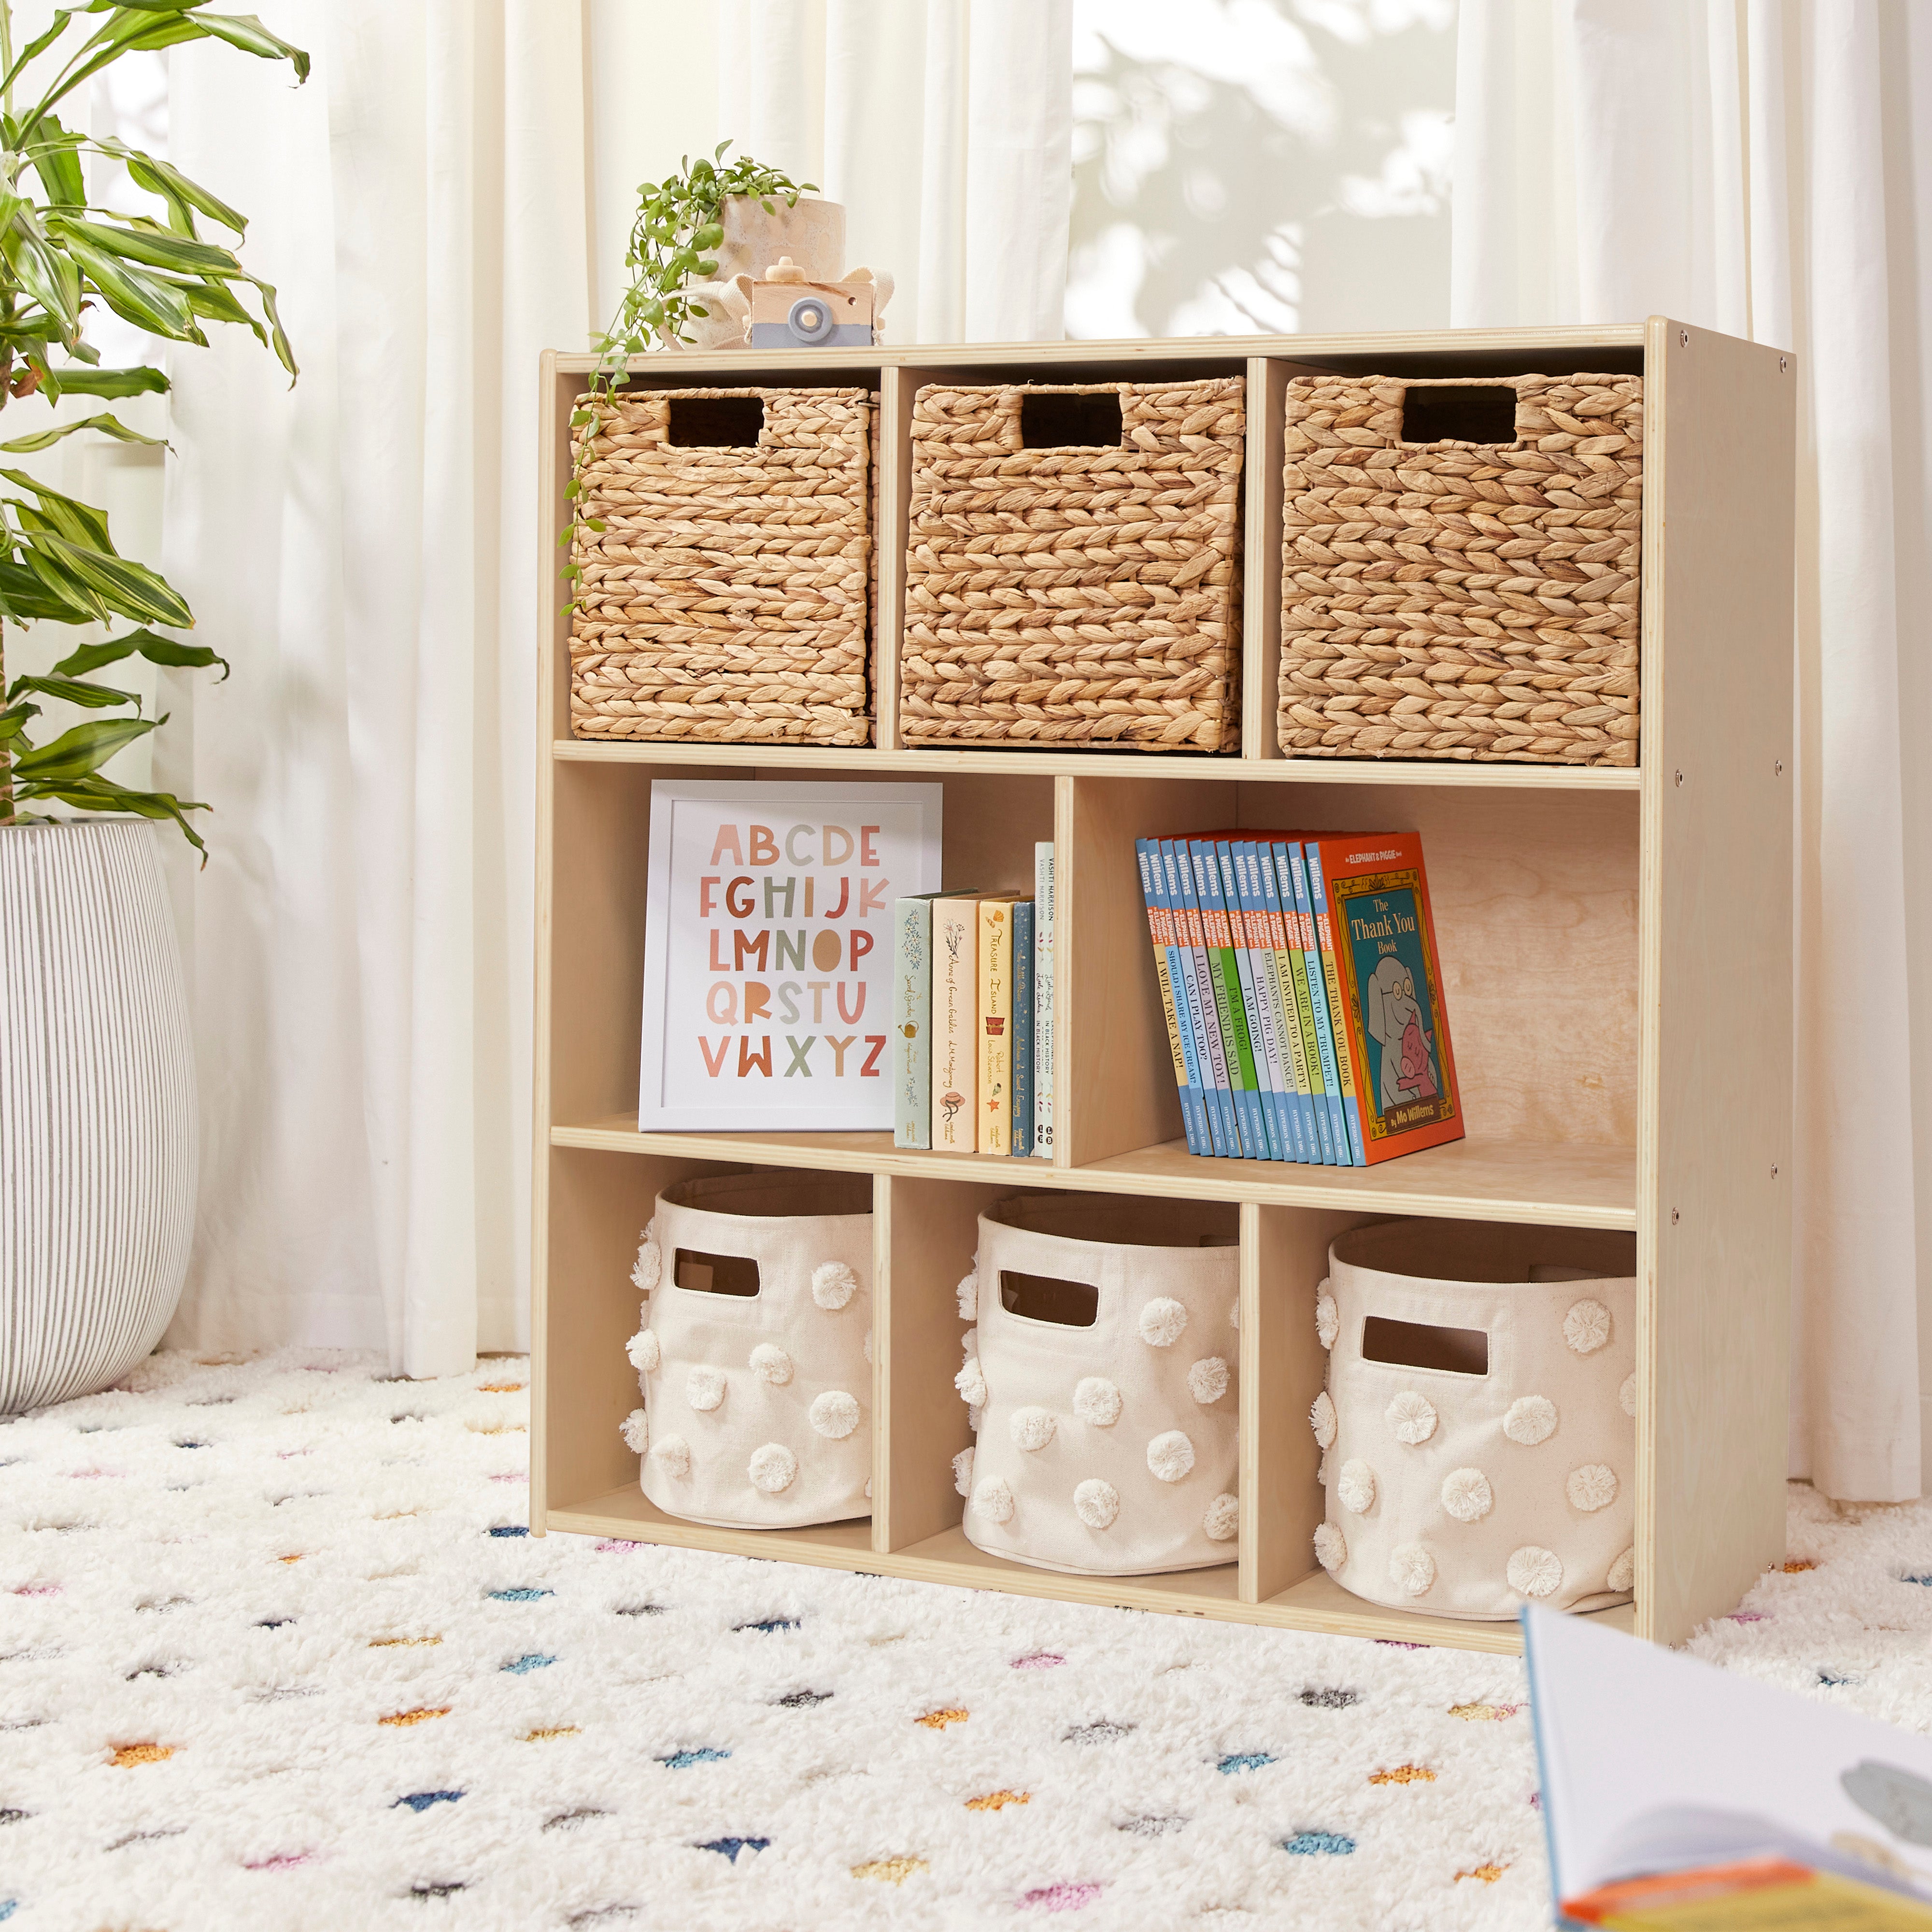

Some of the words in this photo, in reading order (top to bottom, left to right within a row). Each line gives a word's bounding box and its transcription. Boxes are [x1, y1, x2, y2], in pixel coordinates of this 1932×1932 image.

[710, 824, 880, 867] ABCDE
[1349, 852, 1375, 864] ELEPHANT
[1379, 850, 1396, 860] PIGGIE
[1137, 852, 1152, 893] Willems
[1149, 853, 1165, 895] Willems
[1163, 854, 1179, 895] Willems
[1177, 853, 1193, 895] Willems
[1192, 855, 1208, 896] Willems
[1204, 854, 1220, 896] Willems
[1219, 855, 1236, 897] Willems
[1235, 855, 1250, 896] Willems
[1246, 854, 1262, 896] Willems
[1260, 856, 1276, 898] Willems
[1276, 855, 1292, 897] Willems
[1290, 857, 1305, 899] Willems
[1308, 857, 1324, 899] Willems
[700, 876, 890, 919] FGHIJK
[1373, 899, 1388, 912] The
[1148, 915, 1156, 935] PIGGIE
[1153, 911, 1163, 942] ELEPHANT
[1160, 917, 1168, 937] PIGGIE
[1164, 913, 1175, 945] ELEPHANT
[1174, 917, 1182, 938] PIGGIE
[1179, 914, 1189, 945] ELEPHANT
[1187, 917, 1196, 937] PIGGIE
[1192, 914, 1204, 945] ELEPHANT
[1202, 918, 1211, 938] PIGGIE
[1207, 915, 1218, 946] ELEPHANT
[1214, 919, 1223, 938] PIGGIE
[1220, 915, 1231, 946] ELEPHANT
[1230, 919, 1239, 939] PIGGIE
[1235, 914, 1246, 947] ELEPHANT
[1244, 919, 1253, 939] PIGGIE
[1250, 916, 1260, 947] ELEPHANT
[1256, 919, 1265, 939] PIGGIE
[1261, 915, 1272, 947] ELEPHANT
[1270, 920, 1279, 940] PIGGIE
[1275, 917, 1286, 949] ELEPHANT
[1285, 920, 1294, 940] PIGGIE
[1291, 916, 1301, 949] ELEPHANT
[1299, 921, 1308, 941] PIGGIE
[1305, 918, 1315, 950] ELEPHANT
[1317, 922, 1326, 942] PIGGIE
[1323, 919, 1333, 951] ELEPHANT
[1351, 915, 1393, 940] Thank
[1392, 913, 1415, 933] You
[709, 929, 874, 972] LMNOP
[1378, 939, 1397, 954] Book
[948, 955, 959, 976] Anne
[1167, 951, 1179, 983] SHOULD
[1196, 963, 1210, 995] LOVE
[1211, 963, 1223, 982] MY
[1264, 952, 1280, 1009] ELEPHANTS
[1279, 962, 1289, 978] AM
[1294, 967, 1306, 986] WE
[1307, 961, 1320, 996] LISTEN
[1325, 962, 1335, 983] THE
[1159, 966, 1170, 996] WILL
[1185, 975, 1196, 995] CAN
[1255, 977, 1269, 1011] HAPPY
[706, 980, 866, 1026] QRSTU
[948, 986, 957, 1008] Green
[1174, 991, 1185, 1018] SHARE
[1203, 999, 1214, 1020] MY
[1215, 985, 1231, 1031] FRIEND
[1245, 995, 1255, 1010] AM
[1282, 981, 1296, 1022] INVITED
[1298, 990, 1309, 1012] ARE
[1313, 999, 1322, 1013] TO
[1329, 988, 1342, 1026] THANK
[948, 1009, 957, 1034] Gables
[1164, 997, 1176, 1028] TAKE
[1179, 1021, 1188, 1032] MY
[1191, 1006, 1202, 1030] PLAY
[1229, 987, 1239, 1003] I'M
[1234, 1018, 1247, 1050] FROG!
[1262, 1017, 1272, 1034] PIG
[1302, 1016, 1312, 1028] IN
[1316, 1017, 1325, 1031] MY
[1182, 1036, 1191, 1048] ICE
[1207, 1022, 1220, 1050] NEW
[1223, 1036, 1234, 1048] IS
[1248, 1014, 1262, 1052] GOING!
[1274, 1012, 1287, 1049] CANNOT
[1289, 1024, 1299, 1038] TO
[1335, 1030, 1346, 1052] YOU
[698, 1035, 886, 1077] VWXYZ
[995, 1051, 1004, 1073] Robert
[1171, 1043, 1182, 1068] NAP!
[1195, 1034, 1207, 1060] TOO?
[1265, 1038, 1278, 1064] DAY!
[1307, 1041, 1320, 1076] BOOK!
[1318, 1034, 1334, 1086] TRUMPET!
[1184, 1051, 1196, 1083] CREAM?
[1212, 1054, 1225, 1083] TOY!
[1226, 1051, 1239, 1075] SAD
[1280, 1052, 1293, 1088] DANCE!
[1293, 1051, 1307, 1088] PARTY!
[1339, 1056, 1351, 1086] BOOK
[1391, 1119, 1397, 1128] By
[1396, 1110, 1407, 1124] Mo
[1407, 1105, 1434, 1121] Willems
